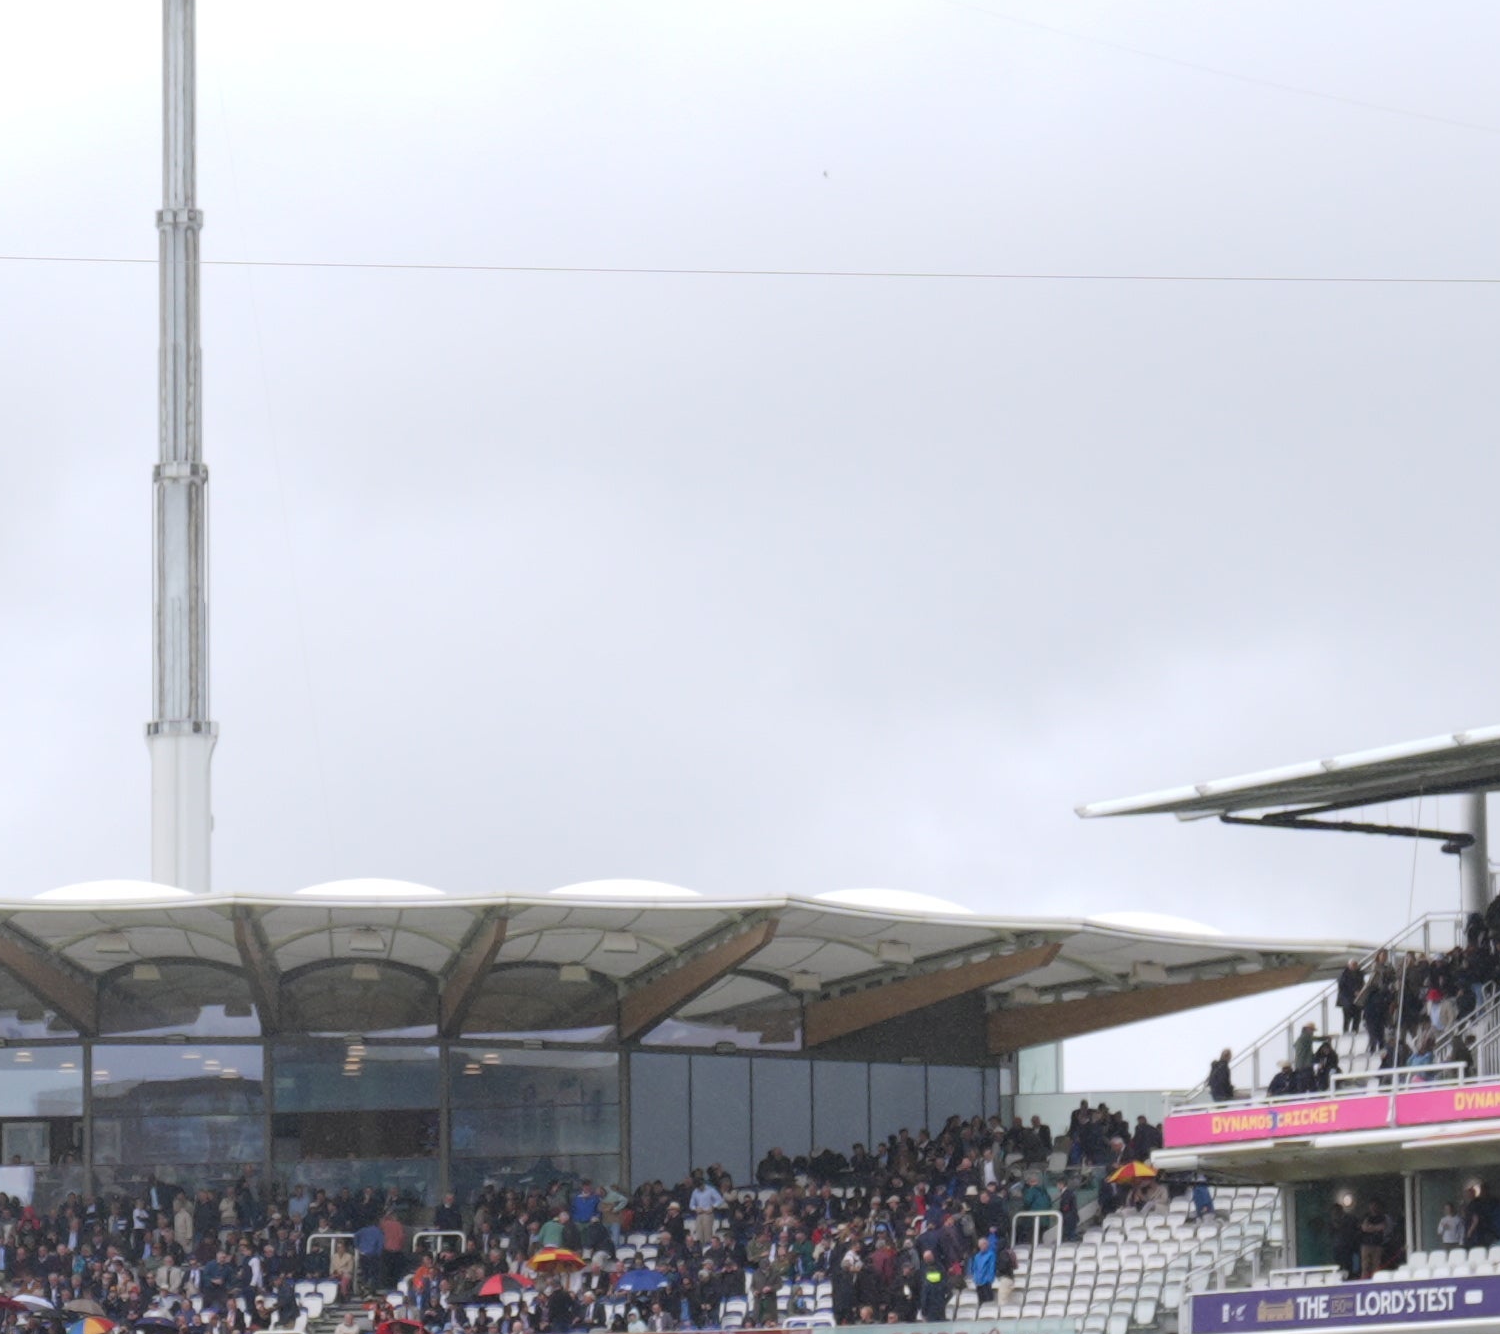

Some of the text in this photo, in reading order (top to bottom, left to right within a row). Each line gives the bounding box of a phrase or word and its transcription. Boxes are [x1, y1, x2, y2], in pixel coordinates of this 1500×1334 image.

[1276, 1104, 1339, 1128] CRICKET
[1297, 1295, 1330, 1319] THE
[1355, 1290, 1416, 1316] LORD'S
[1417, 1285, 1458, 1312] TEST
